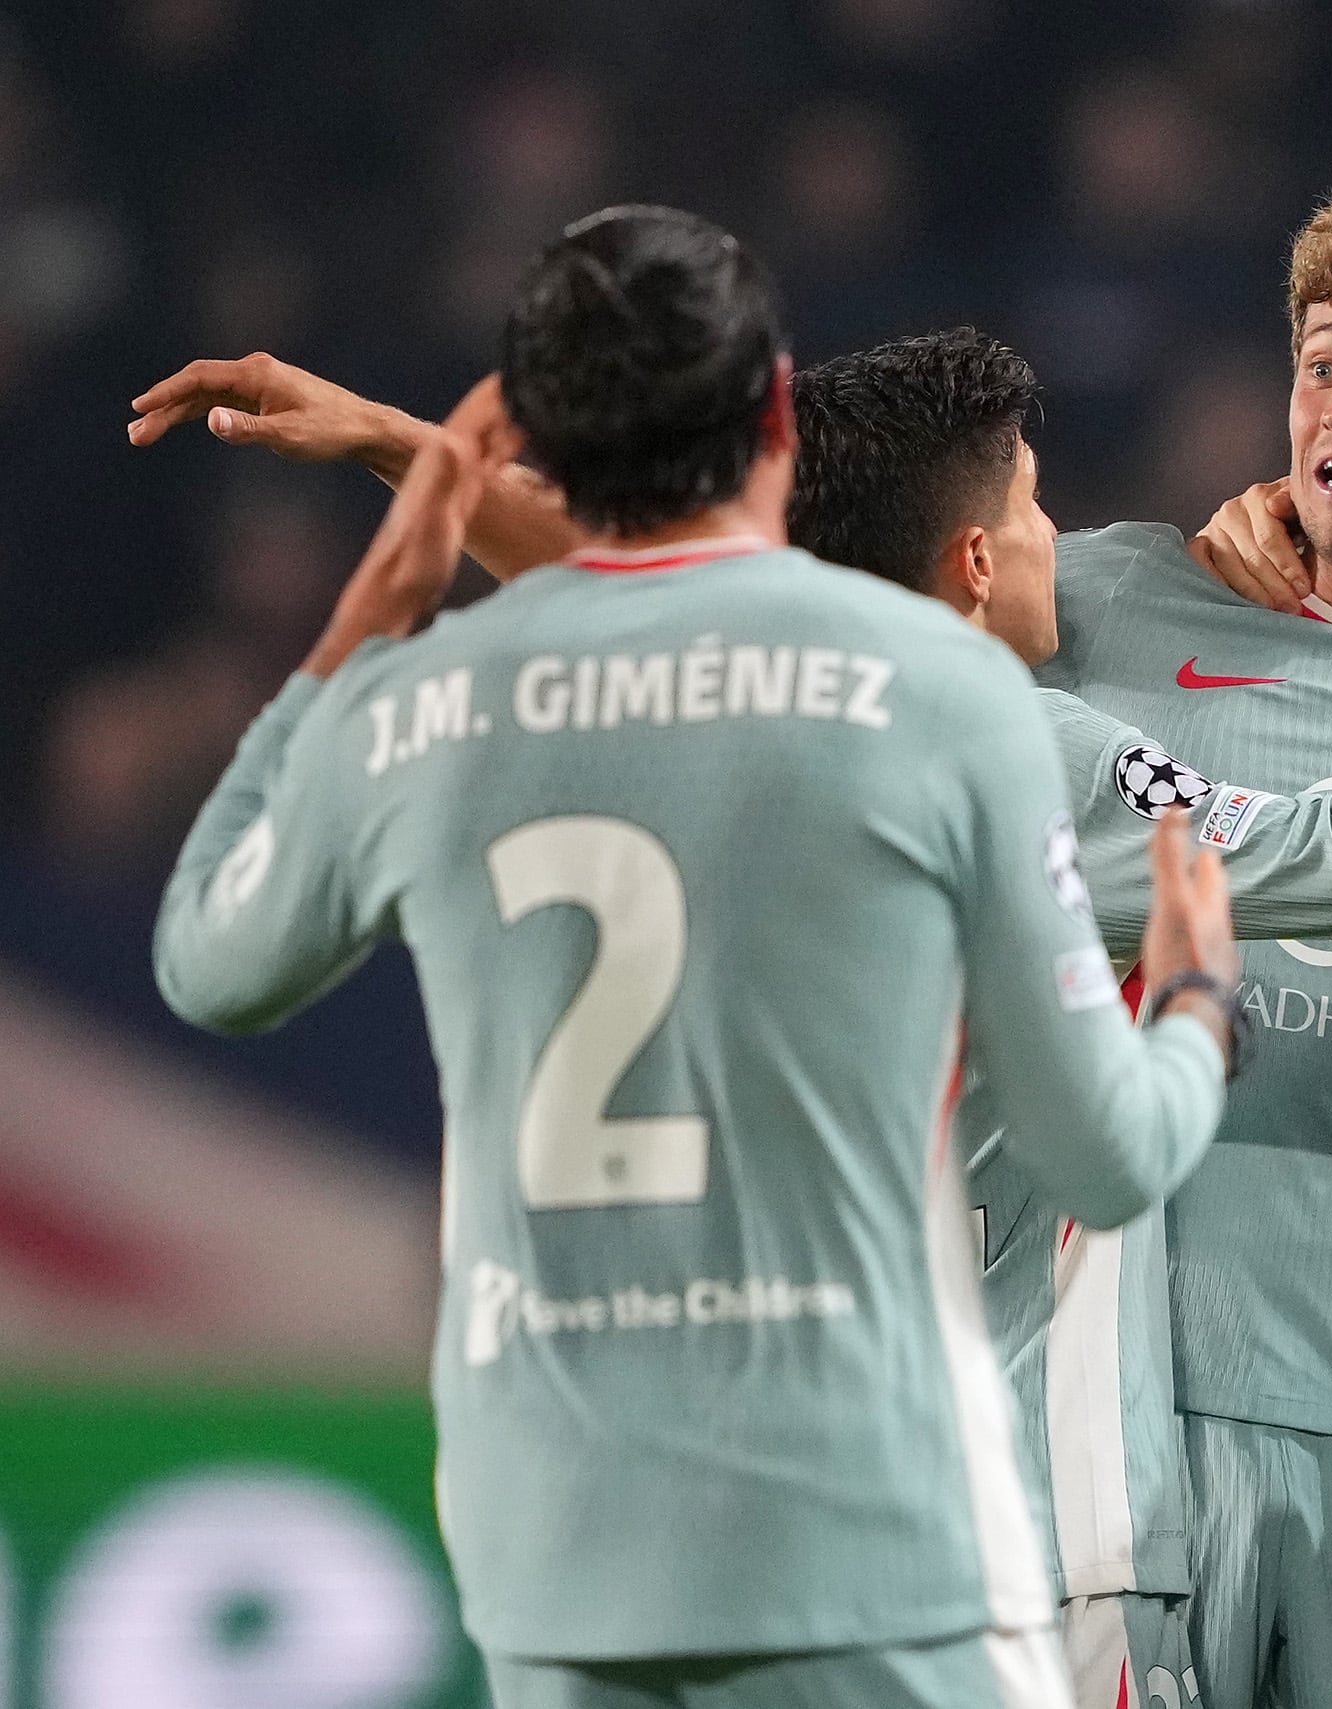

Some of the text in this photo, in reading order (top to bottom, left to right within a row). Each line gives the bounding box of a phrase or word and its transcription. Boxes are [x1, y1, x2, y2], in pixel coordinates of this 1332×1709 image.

[366, 633, 894, 777] J.M. GIMÉNEZ
[1203, 812, 1220, 840] UEFA
[1213, 794, 1249, 844] FOUN
[487, 814, 709, 1211] 2
